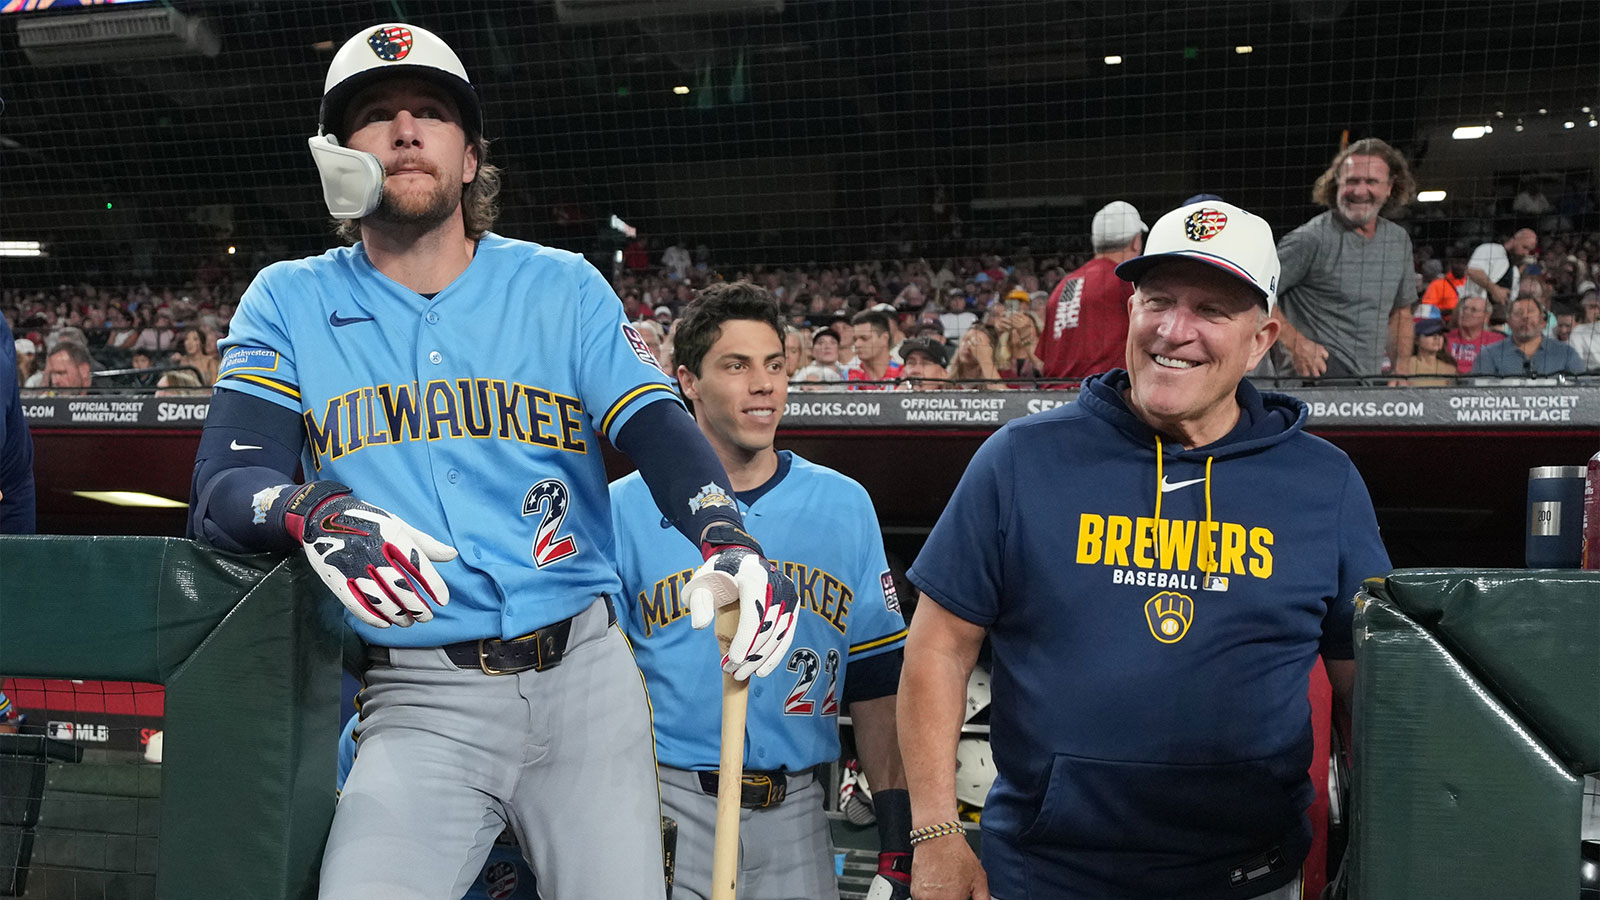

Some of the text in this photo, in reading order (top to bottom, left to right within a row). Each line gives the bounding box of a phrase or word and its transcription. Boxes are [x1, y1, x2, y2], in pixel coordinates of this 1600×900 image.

[68, 402, 143, 412] OFFICIAL TICKET
[901, 398, 1006, 410] OFFICIAL TICKET
[1450, 396, 1579, 409] OFFICIAL TICKET
[72, 412, 138, 422] MARKETPLACE
[906, 410, 999, 422] MARKETPLACE
[1456, 409, 1570, 422] MARKETPLACE
[304, 378, 588, 473] MILWAUKEE
[521, 477, 579, 570] 2
[1076, 513, 1274, 580] BREWERS
[1112, 569, 1198, 590] BASEBALL
[782, 647, 841, 717] 22
[76, 724, 109, 742] MLB
